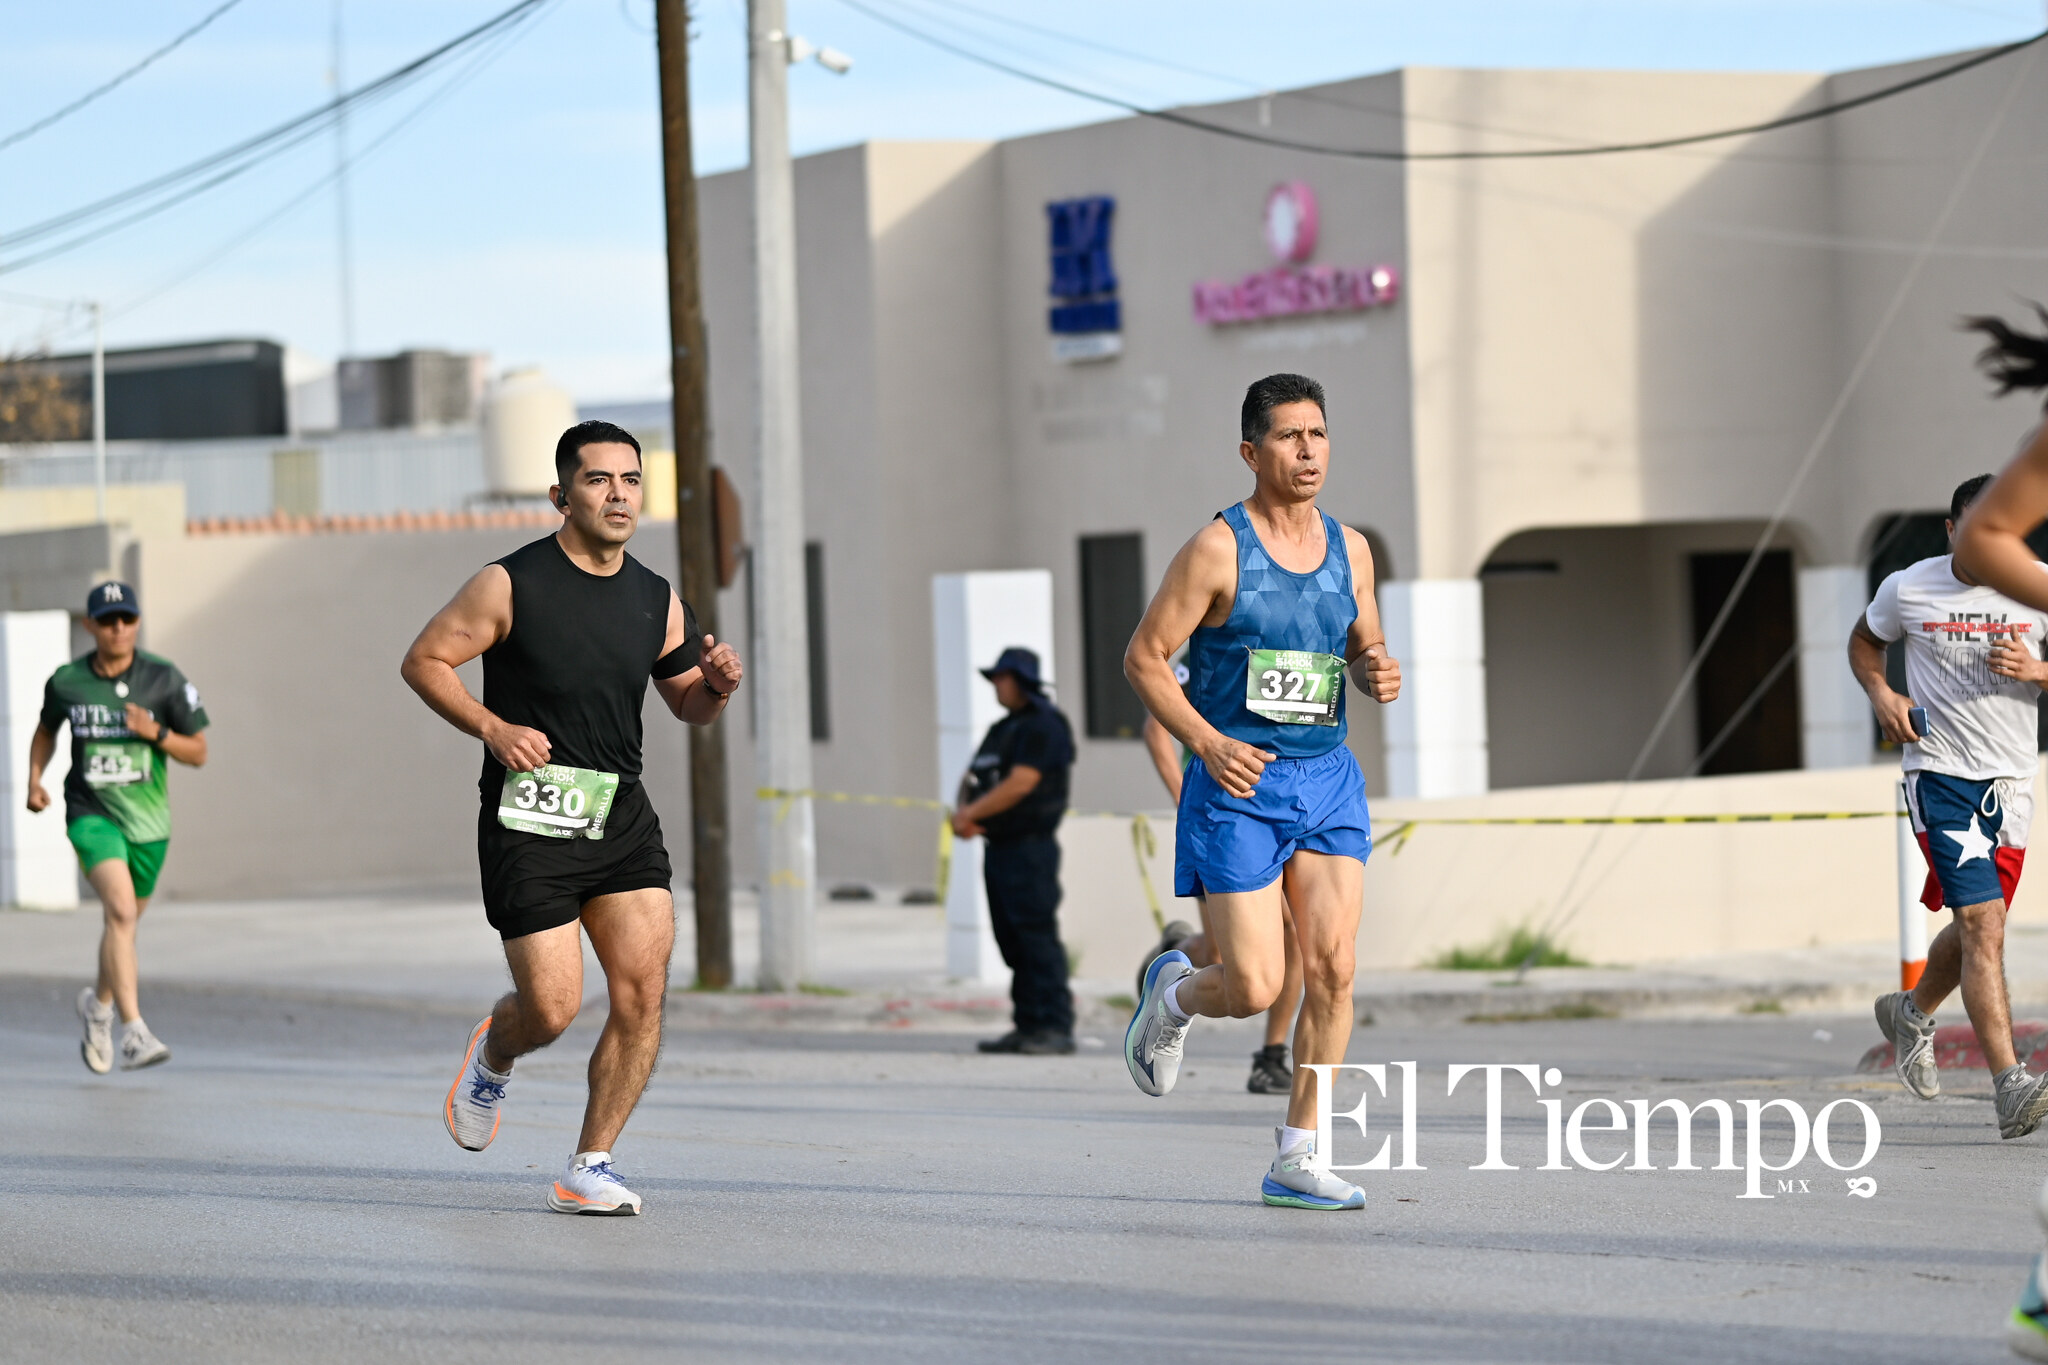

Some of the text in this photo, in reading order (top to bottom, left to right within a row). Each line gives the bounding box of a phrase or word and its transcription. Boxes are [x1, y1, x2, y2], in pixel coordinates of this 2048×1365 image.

[1948, 612, 2007, 642] NEW
[1930, 646, 2017, 686] YOR
[1261, 670, 1322, 701] 327
[1328, 671, 1340, 718] MEDALLA
[90, 755, 133, 772] 542
[515, 780, 586, 817] 330
[591, 788, 612, 832] MEDALLA
